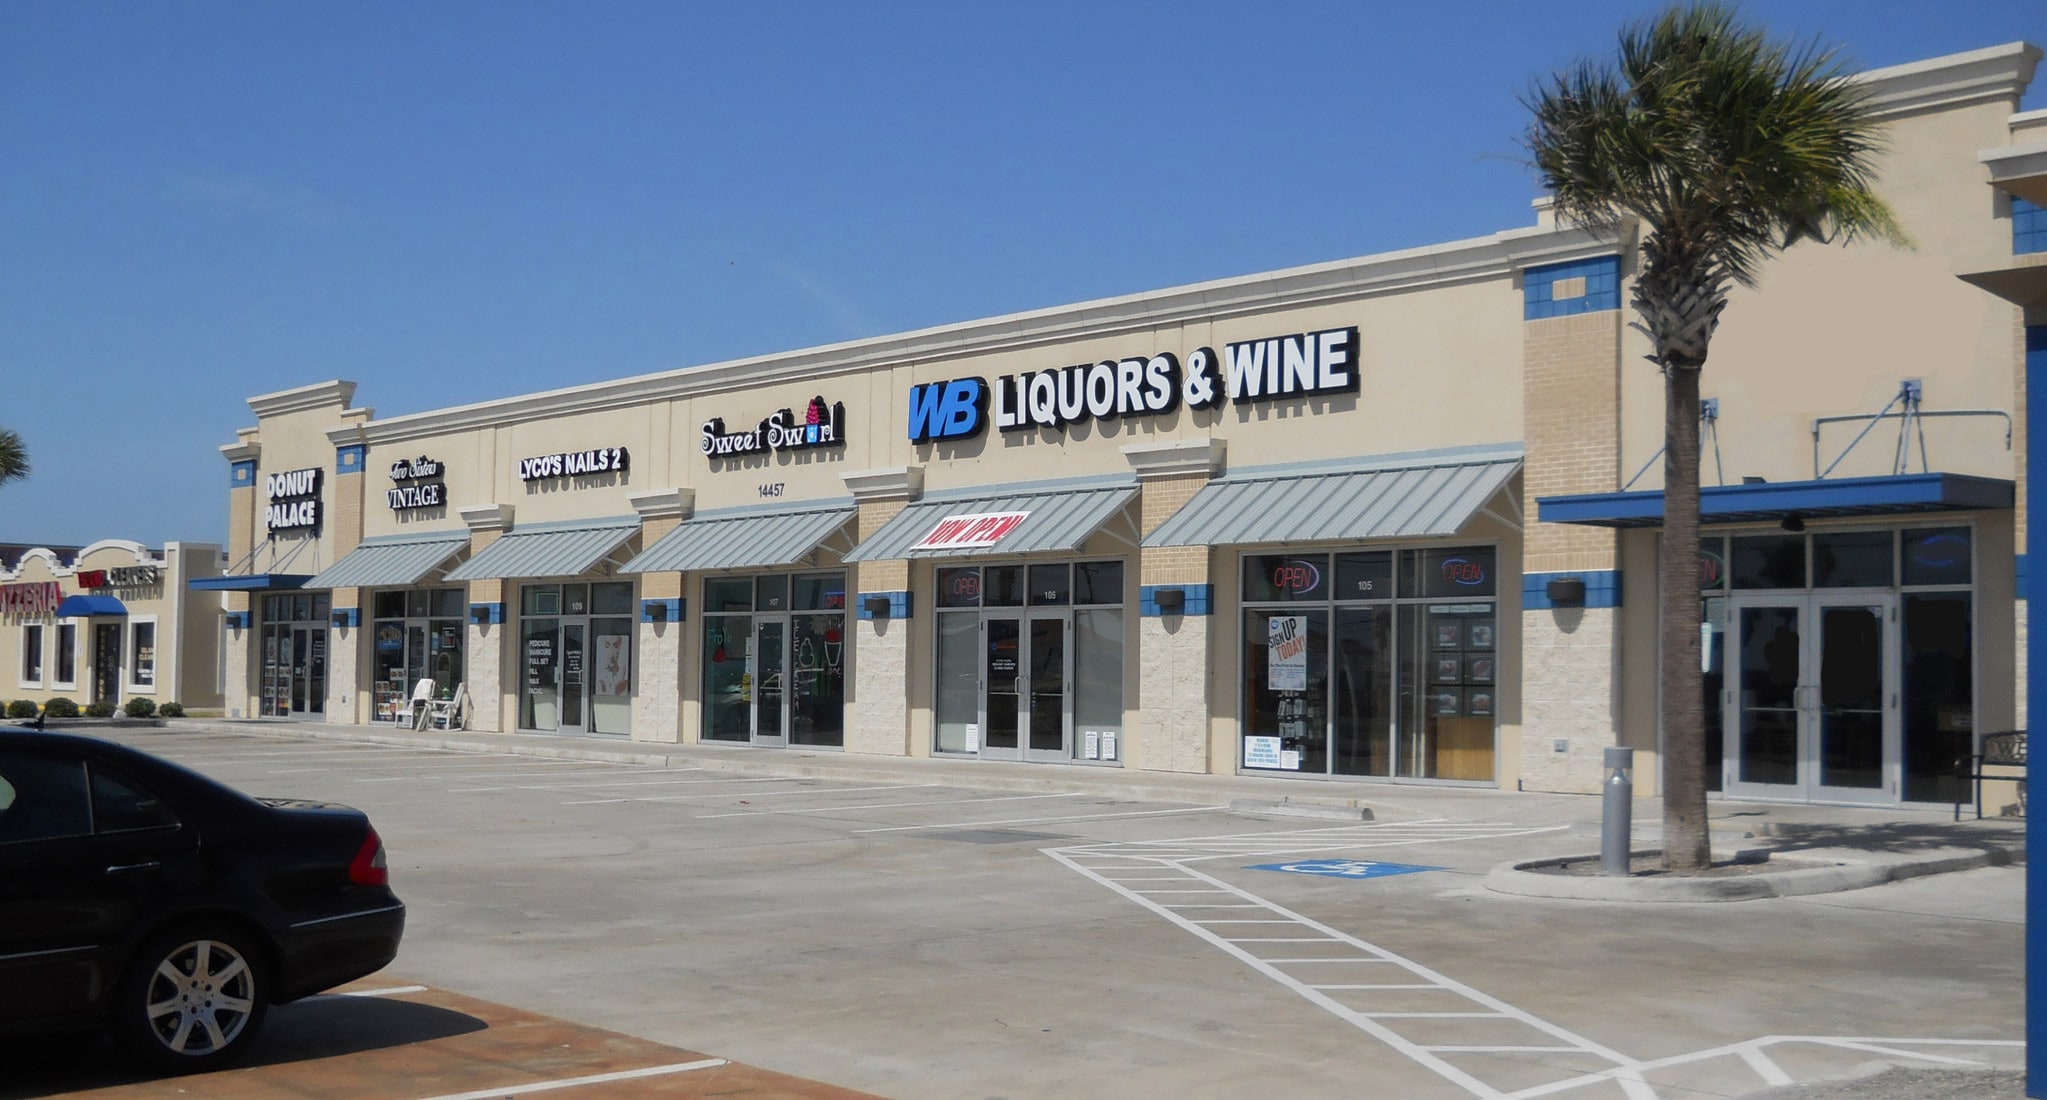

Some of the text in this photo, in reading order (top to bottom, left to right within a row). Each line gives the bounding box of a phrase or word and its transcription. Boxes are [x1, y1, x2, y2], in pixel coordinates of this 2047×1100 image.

[908, 330, 1348, 439] WB LIQUORS & WINE
[701, 420, 762, 456] Sweet
[388, 456, 437, 480] Two Sisters
[518, 448, 621, 479] LYCO'S NAILS 2
[266, 469, 316, 498] DONUT
[385, 484, 439, 508] VINTAGE
[758, 483, 785, 498] 14457
[265, 500, 315, 528] PALACE
[1274, 567, 1312, 588] OPEN
[1441, 563, 1481, 580] OPEN
[0, 582, 59, 613] IZZERIA
[1358, 580, 1373, 591] 105
[572, 602, 583, 611] 109
[1268, 632, 1285, 648] SIGN
[1282, 617, 1297, 641] UP
